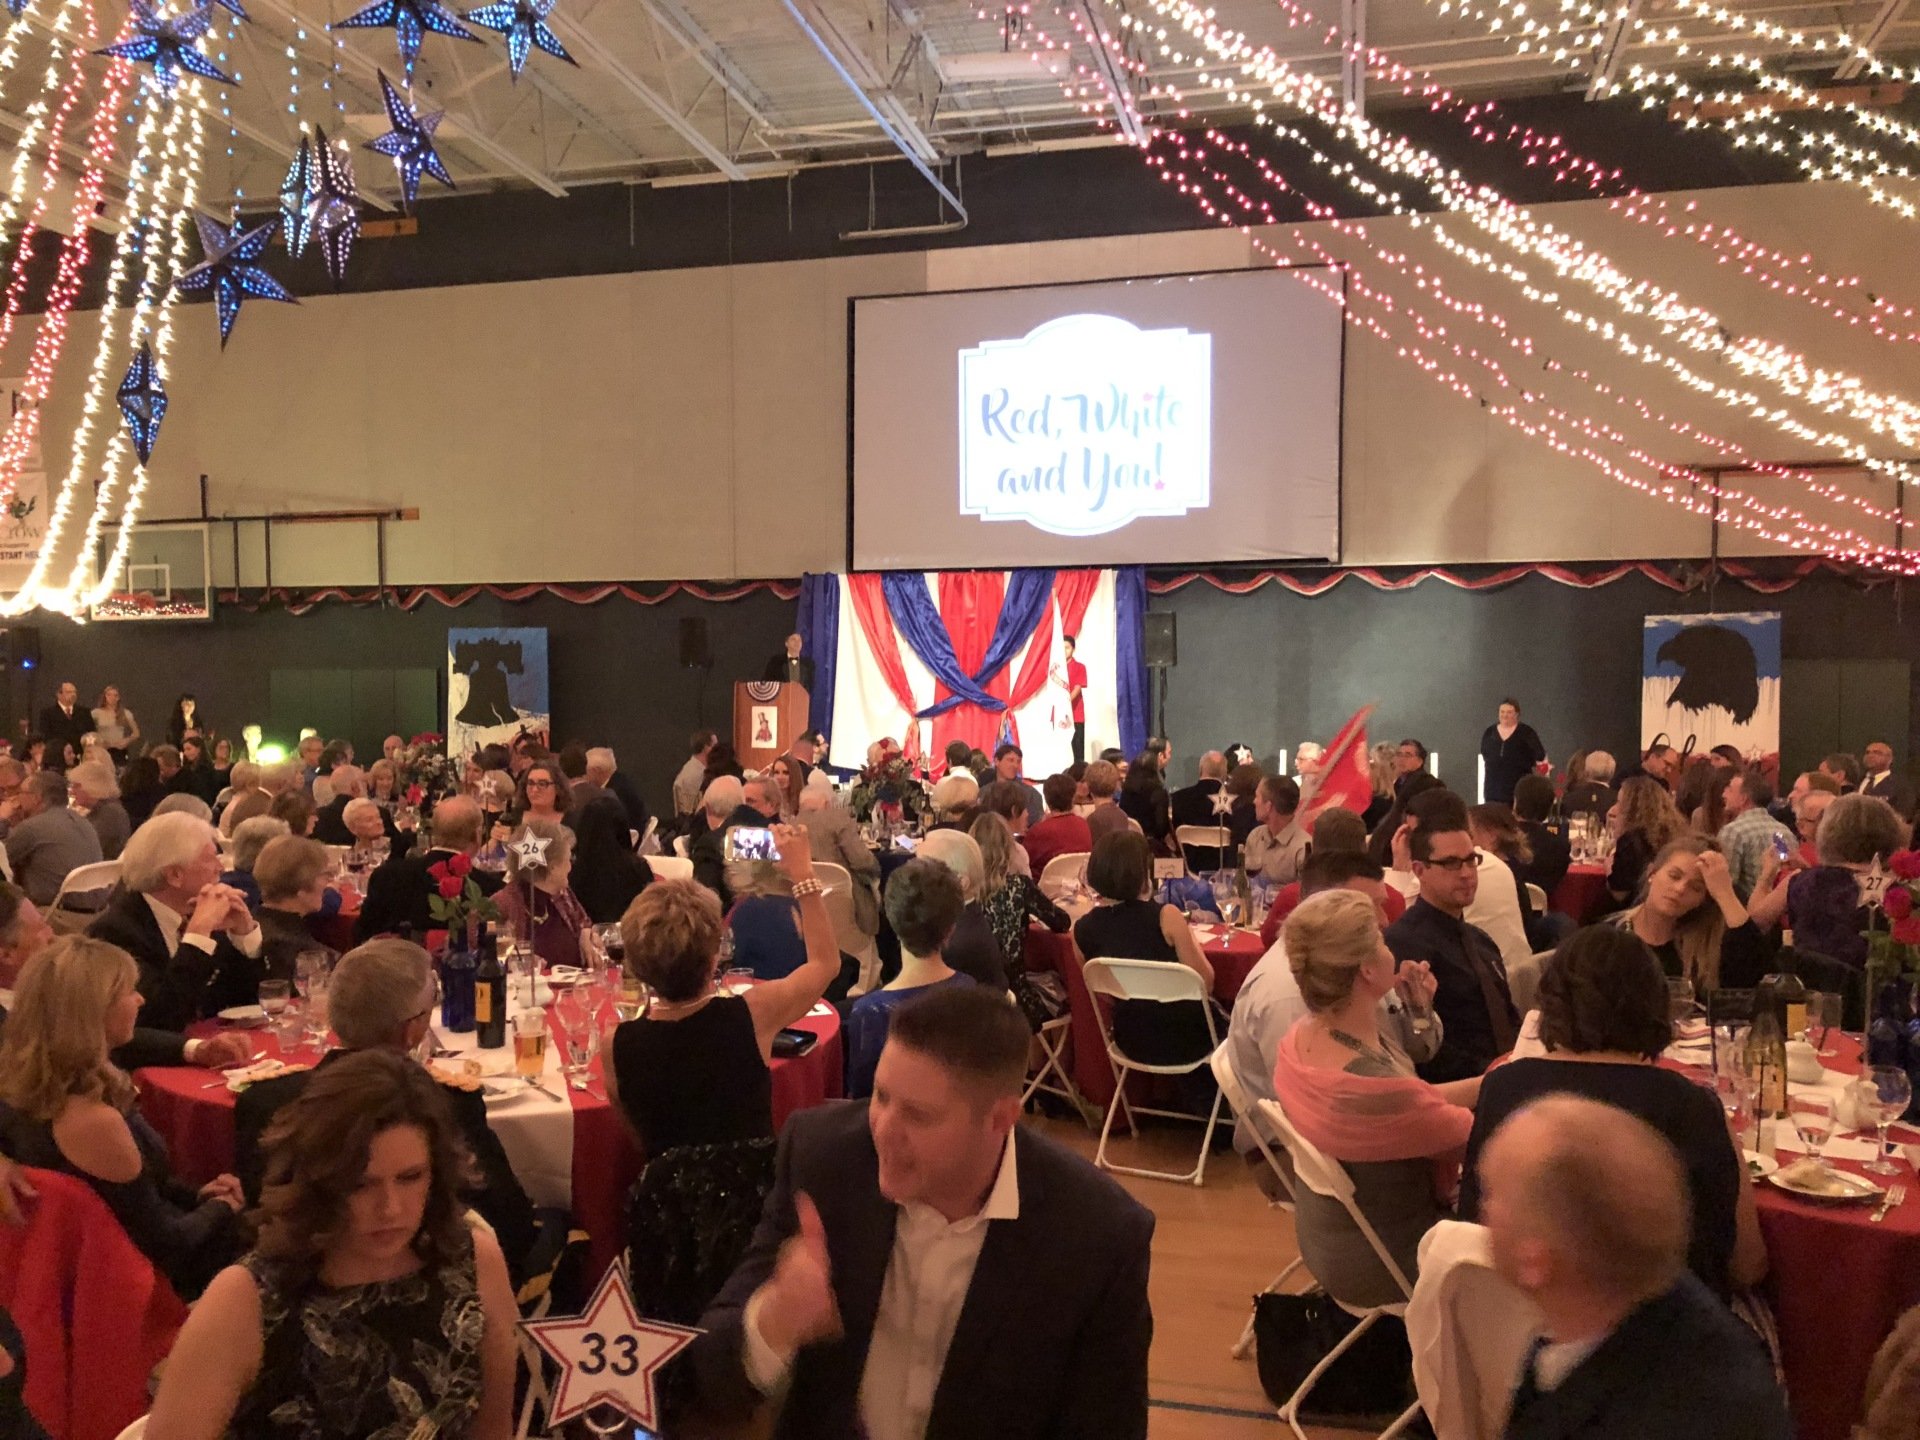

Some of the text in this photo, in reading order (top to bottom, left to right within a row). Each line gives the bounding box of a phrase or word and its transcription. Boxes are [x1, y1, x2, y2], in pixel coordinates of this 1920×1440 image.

[981, 382, 1184, 445] Red, White
[997, 442, 1166, 513] and You!
[522, 842, 539, 855] 26
[1865, 876, 1884, 890] 27
[578, 1332, 639, 1377] 33
